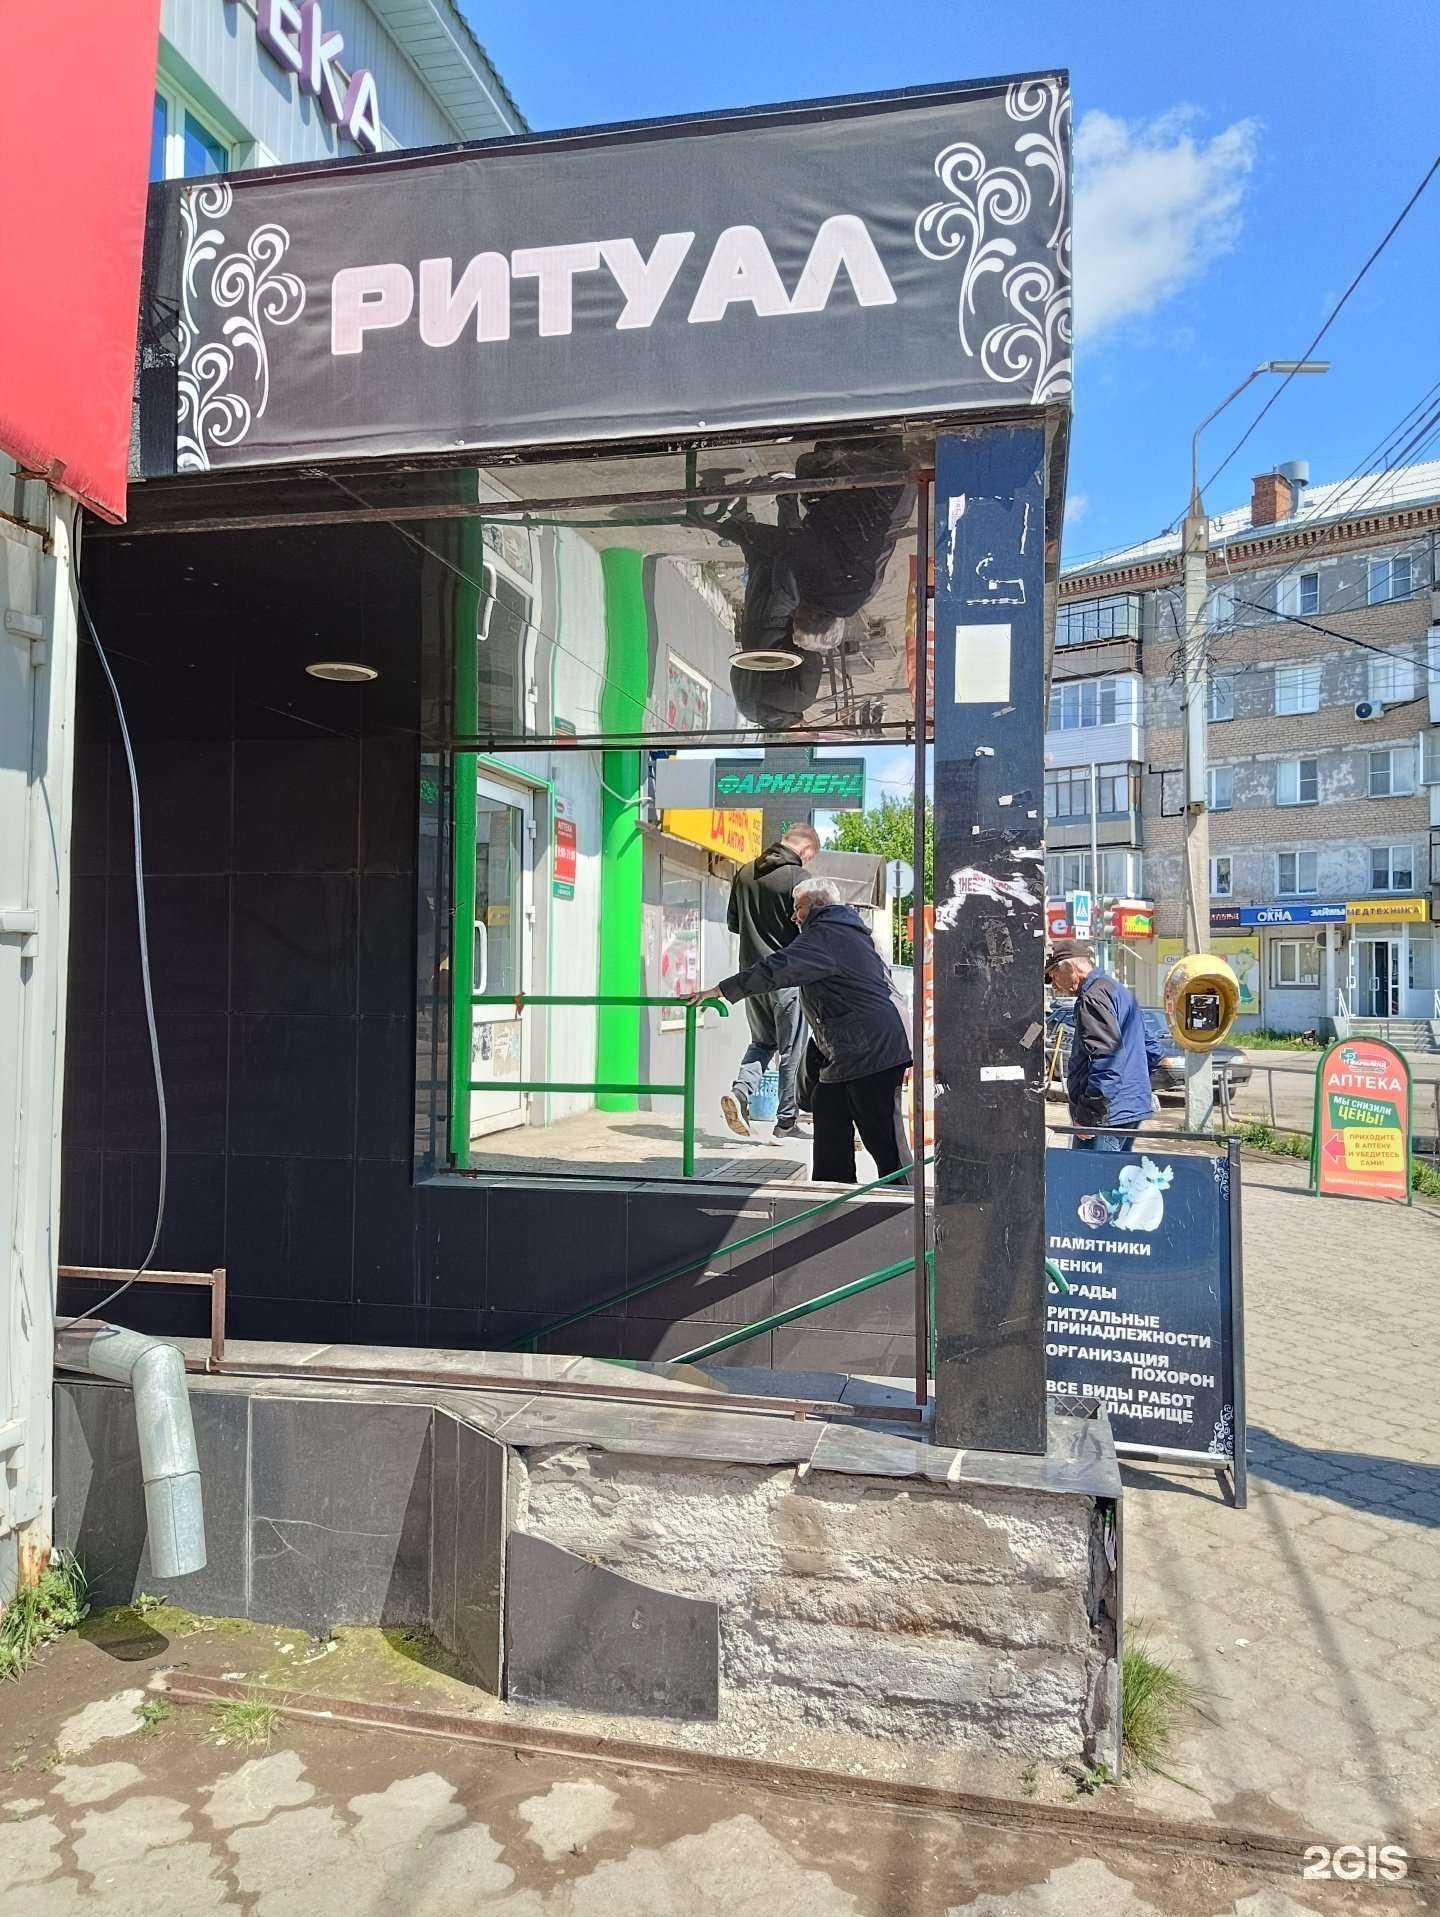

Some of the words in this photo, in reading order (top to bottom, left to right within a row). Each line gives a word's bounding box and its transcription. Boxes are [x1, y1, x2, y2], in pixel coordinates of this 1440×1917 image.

[331, 214, 897, 355] РИТУАЛ
[717, 773, 864, 797] ФАРМЛЕНД
[1257, 909, 1292, 922] ОКНА
[1347, 906, 1420, 917] МЕДТЕХНИКА
[1328, 1073, 1402, 1091] АПТЕКА
[1333, 1095, 1350, 1106] МЫ
[1351, 1099, 1392, 1116] СНИЗИЛИ
[1338, 1106, 1385, 1126] ЦЕНЫ!
[1349, 1134, 1395, 1142] ПРИХОДИТЕ
[1355, 1151, 1400, 1159] УБЕДИТЕСЬ
[1049, 1236, 1151, 1256] ПАМЯТНИКИ
[1047, 1281, 1117, 1300] ОРАДЫ
[1047, 1306, 1160, 1328] РИТУАЛЬНЫЕ
[1046, 1320, 1211, 1349] ПРИНАДЛЕЖНОСТИ
[1045, 1343, 1169, 1368] ОРГАНИЗАЦИЯ
[1131, 1366, 1215, 1388] ПОХОРОН
[1046, 1380, 1078, 1395] ВСЕ
[1082, 1383, 1133, 1401] ВИДЫ
[1138, 1390, 1195, 1408] РАБОТ
[1104, 1400, 1194, 1424] ЛАДБИЩЕ
